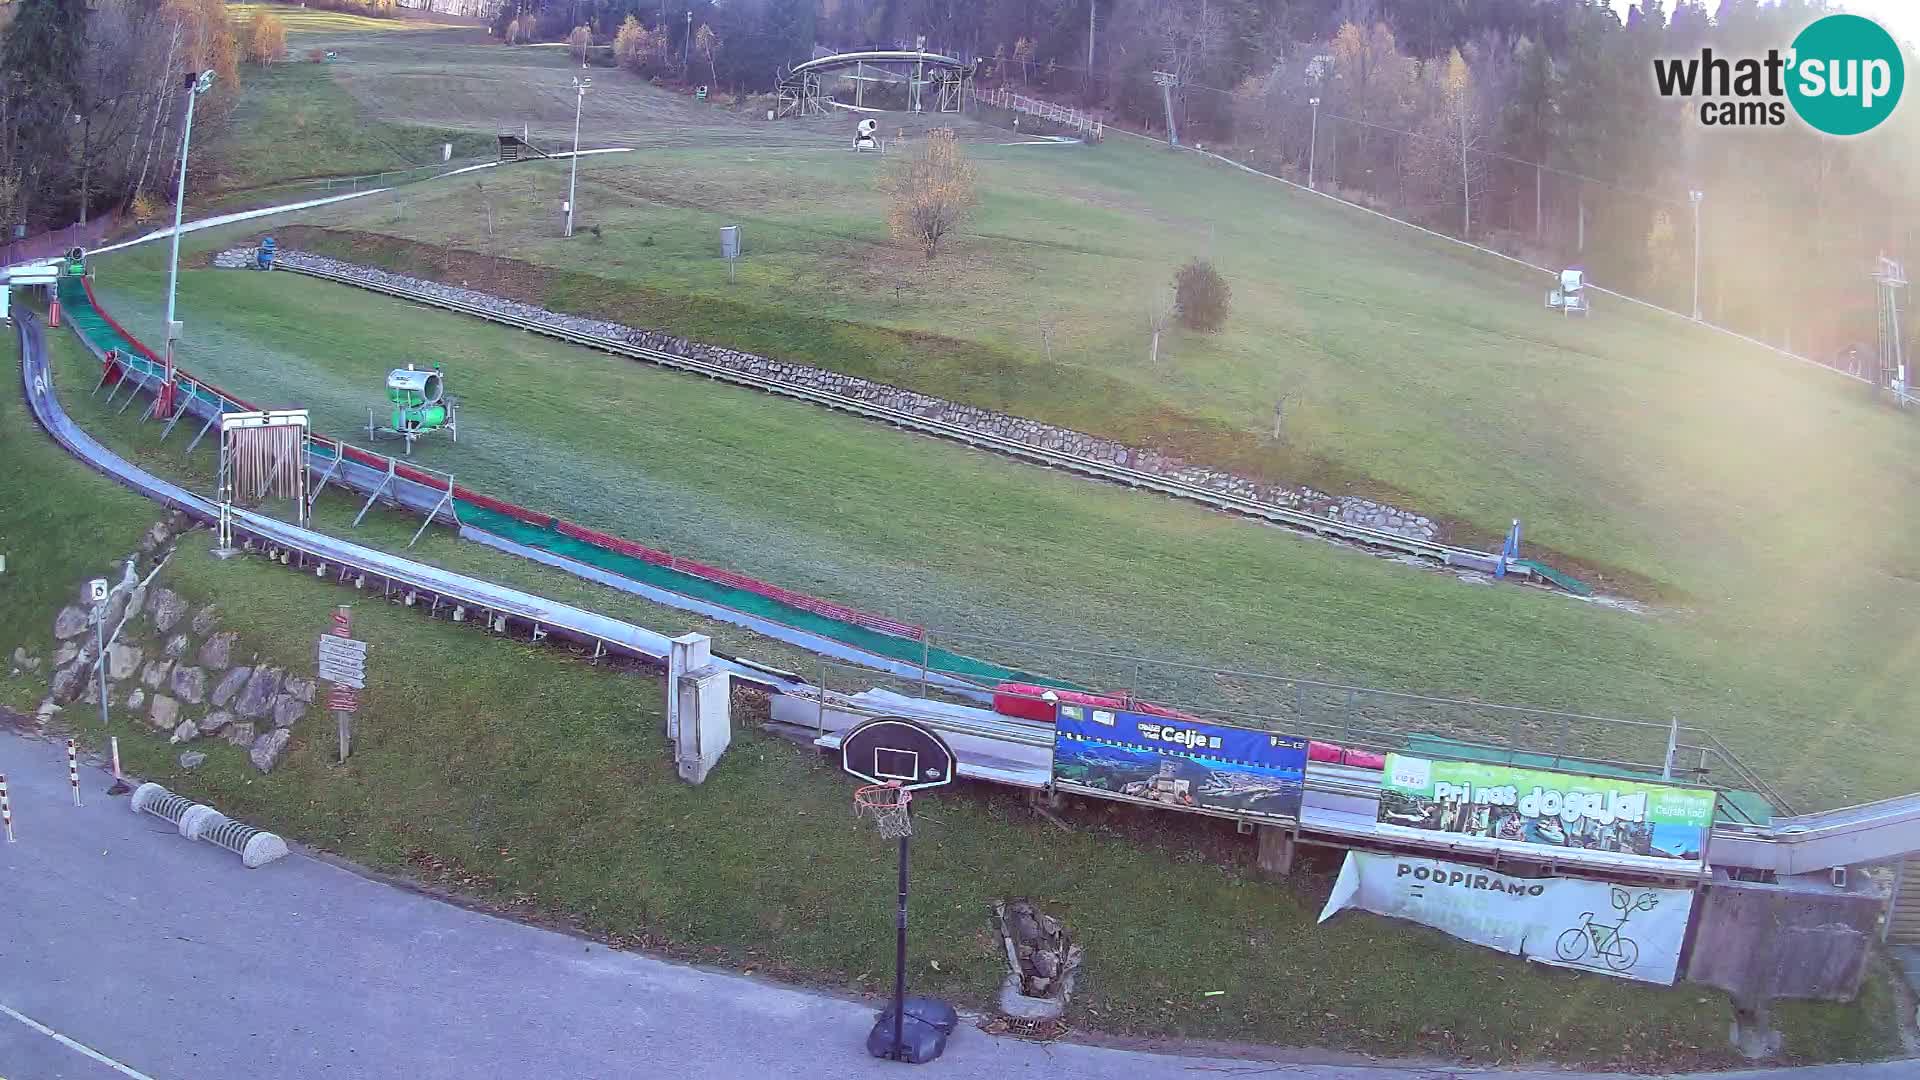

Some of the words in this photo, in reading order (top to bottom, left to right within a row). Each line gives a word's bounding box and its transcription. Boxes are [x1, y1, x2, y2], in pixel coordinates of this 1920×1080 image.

[1161, 726, 1207, 749] Celje
[1434, 781, 1471, 804] Pri
[1475, 784, 1518, 806] nas
[1519, 786, 1647, 825] dogaja!
[1397, 863, 1545, 897] PODPIRAMO
